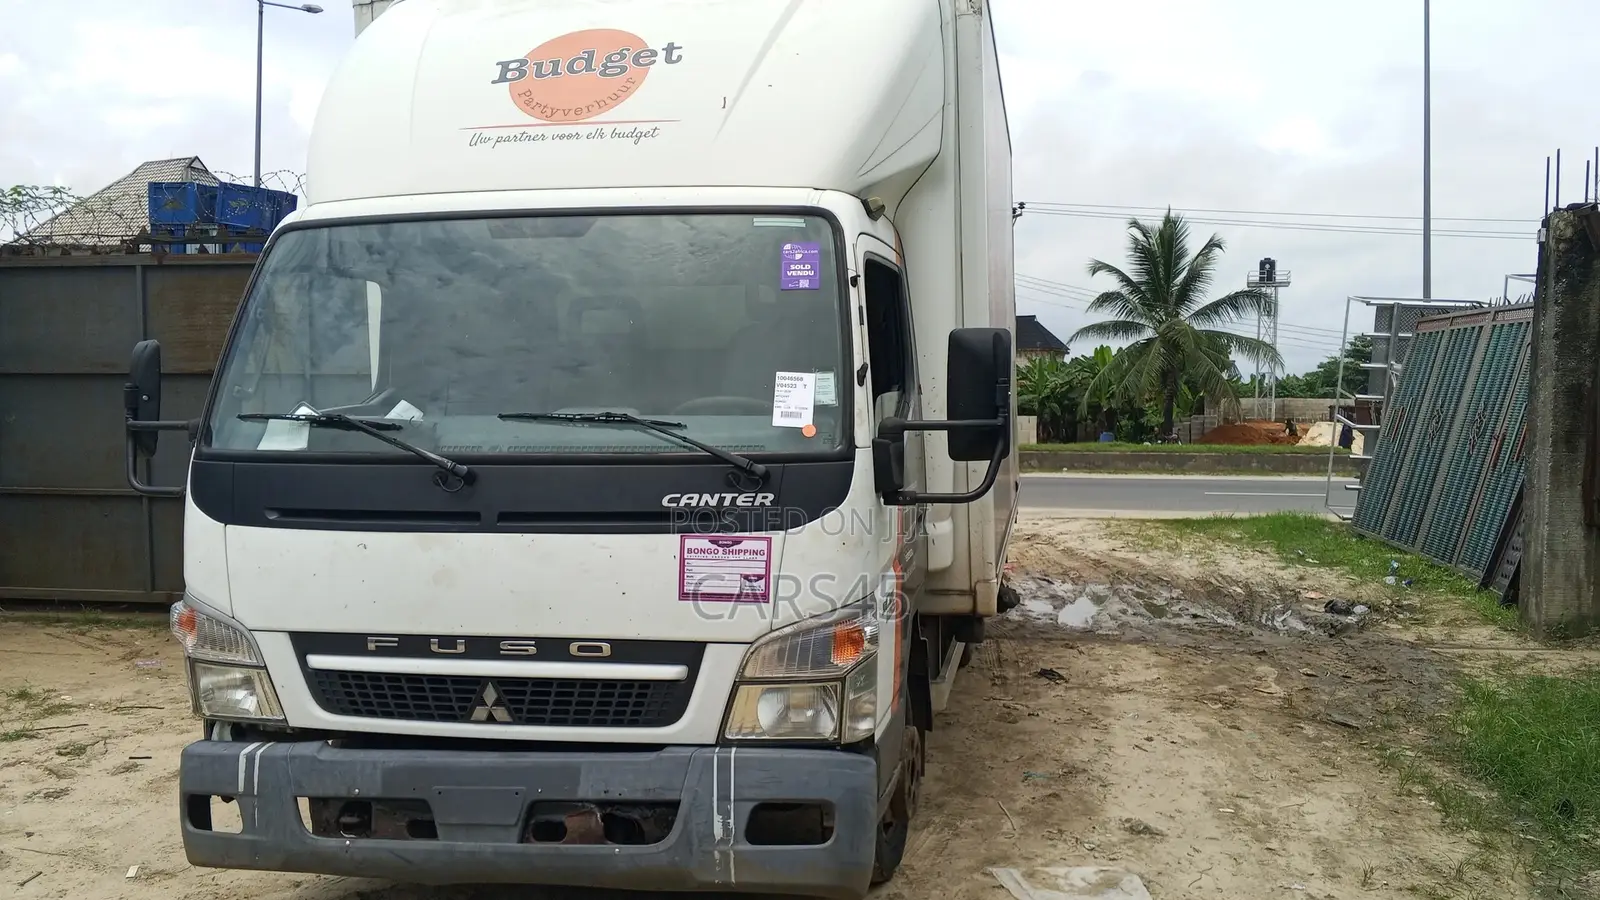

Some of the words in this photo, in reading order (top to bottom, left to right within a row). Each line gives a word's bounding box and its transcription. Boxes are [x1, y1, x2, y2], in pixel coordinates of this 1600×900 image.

[490, 42, 683, 85] Budget
[517, 76, 636, 119] Partyverhuur
[468, 132, 493, 147] Uw
[491, 130, 549, 149] partner
[551, 130, 583, 142] voor
[585, 127, 608, 140] elk
[609, 126, 660, 145] budget
[661, 493, 775, 507] CANTER
[686, 547, 720, 555] BONGO
[722, 548, 766, 557] SHIPPING
[367, 636, 612, 658] FUSO
